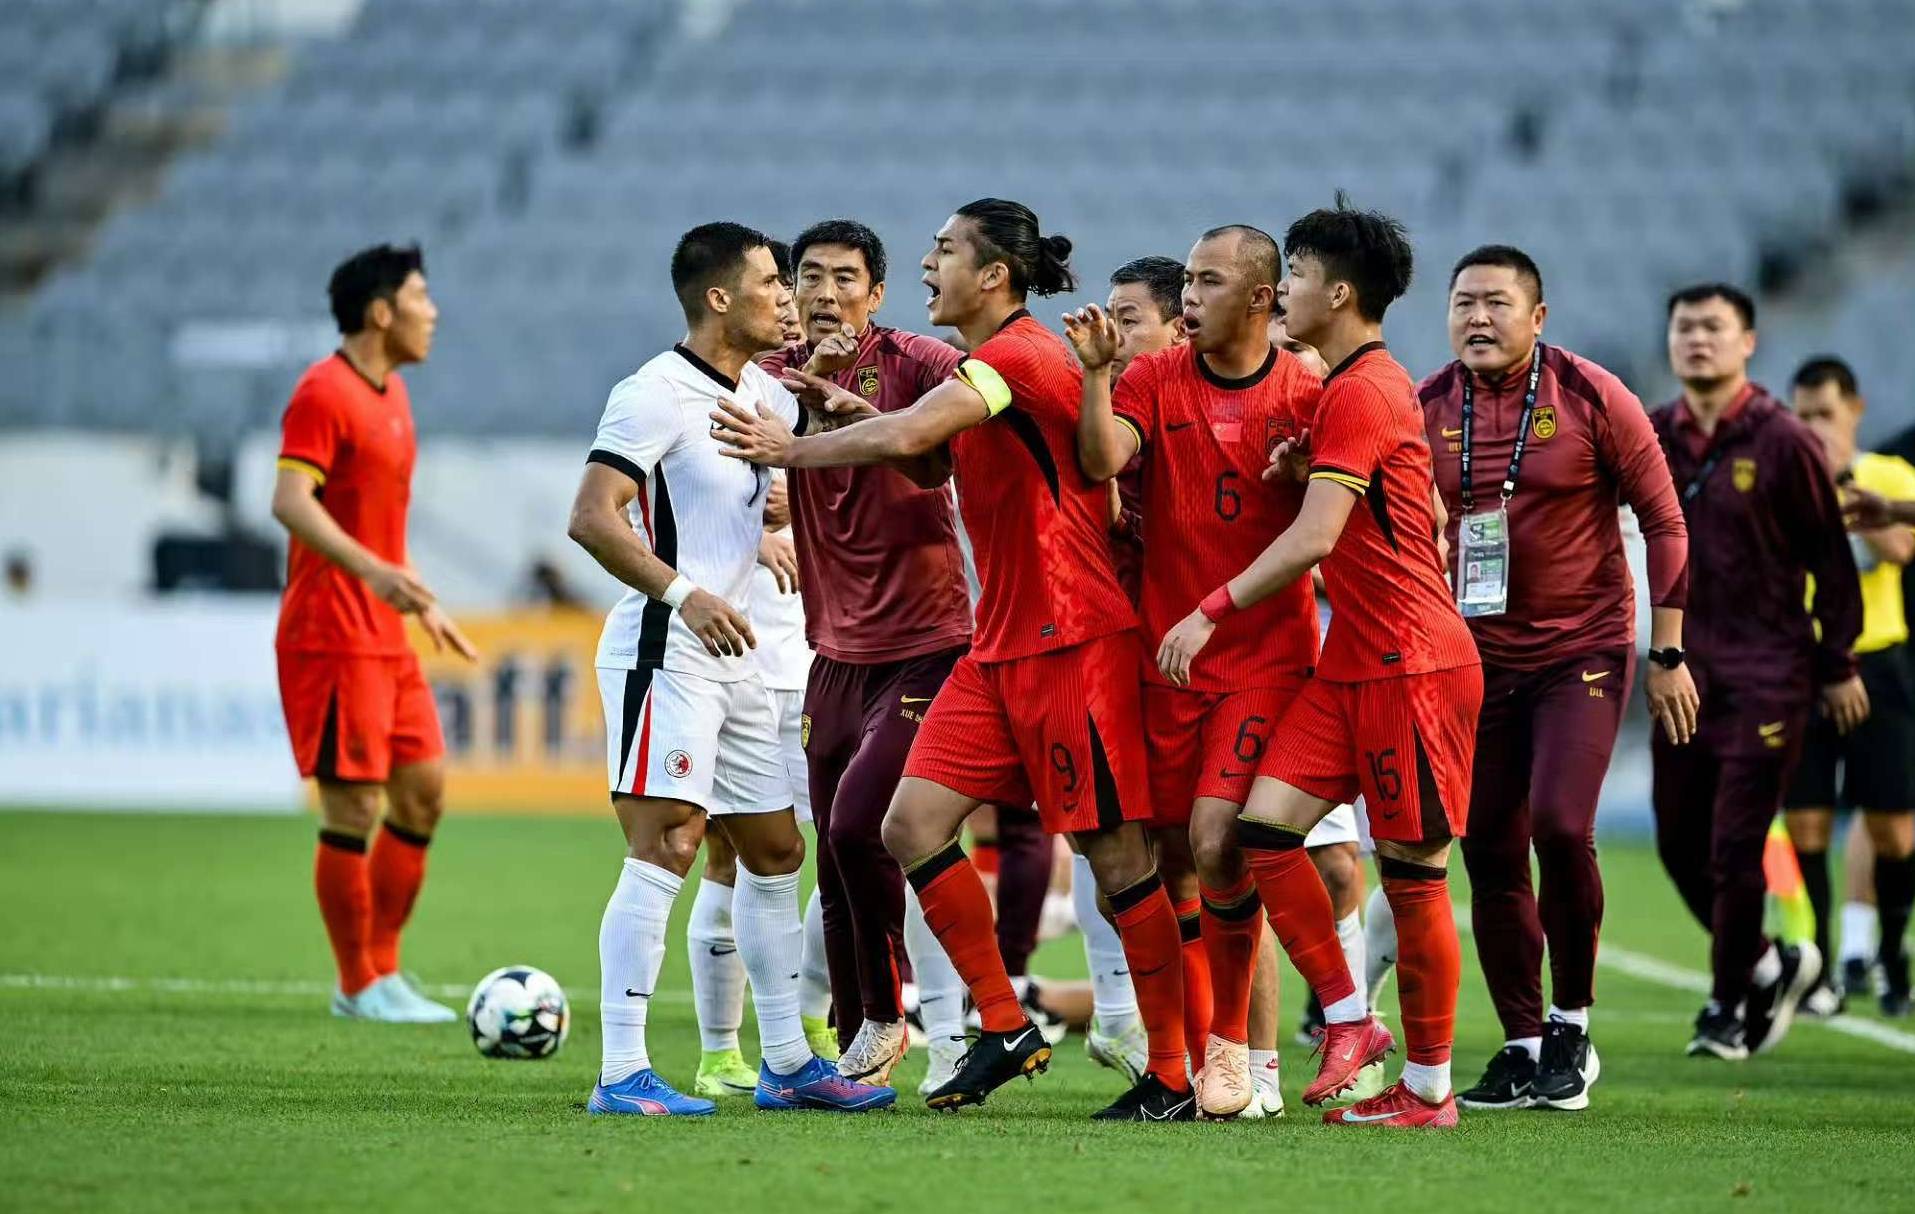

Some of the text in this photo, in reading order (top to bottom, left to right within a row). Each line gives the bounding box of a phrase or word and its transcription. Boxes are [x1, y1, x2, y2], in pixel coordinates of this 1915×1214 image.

[1216, 470, 1242, 522] 6
[1233, 715, 1267, 764] 6
[1051, 742, 1077, 793] 9
[1364, 747, 1403, 802] 15
